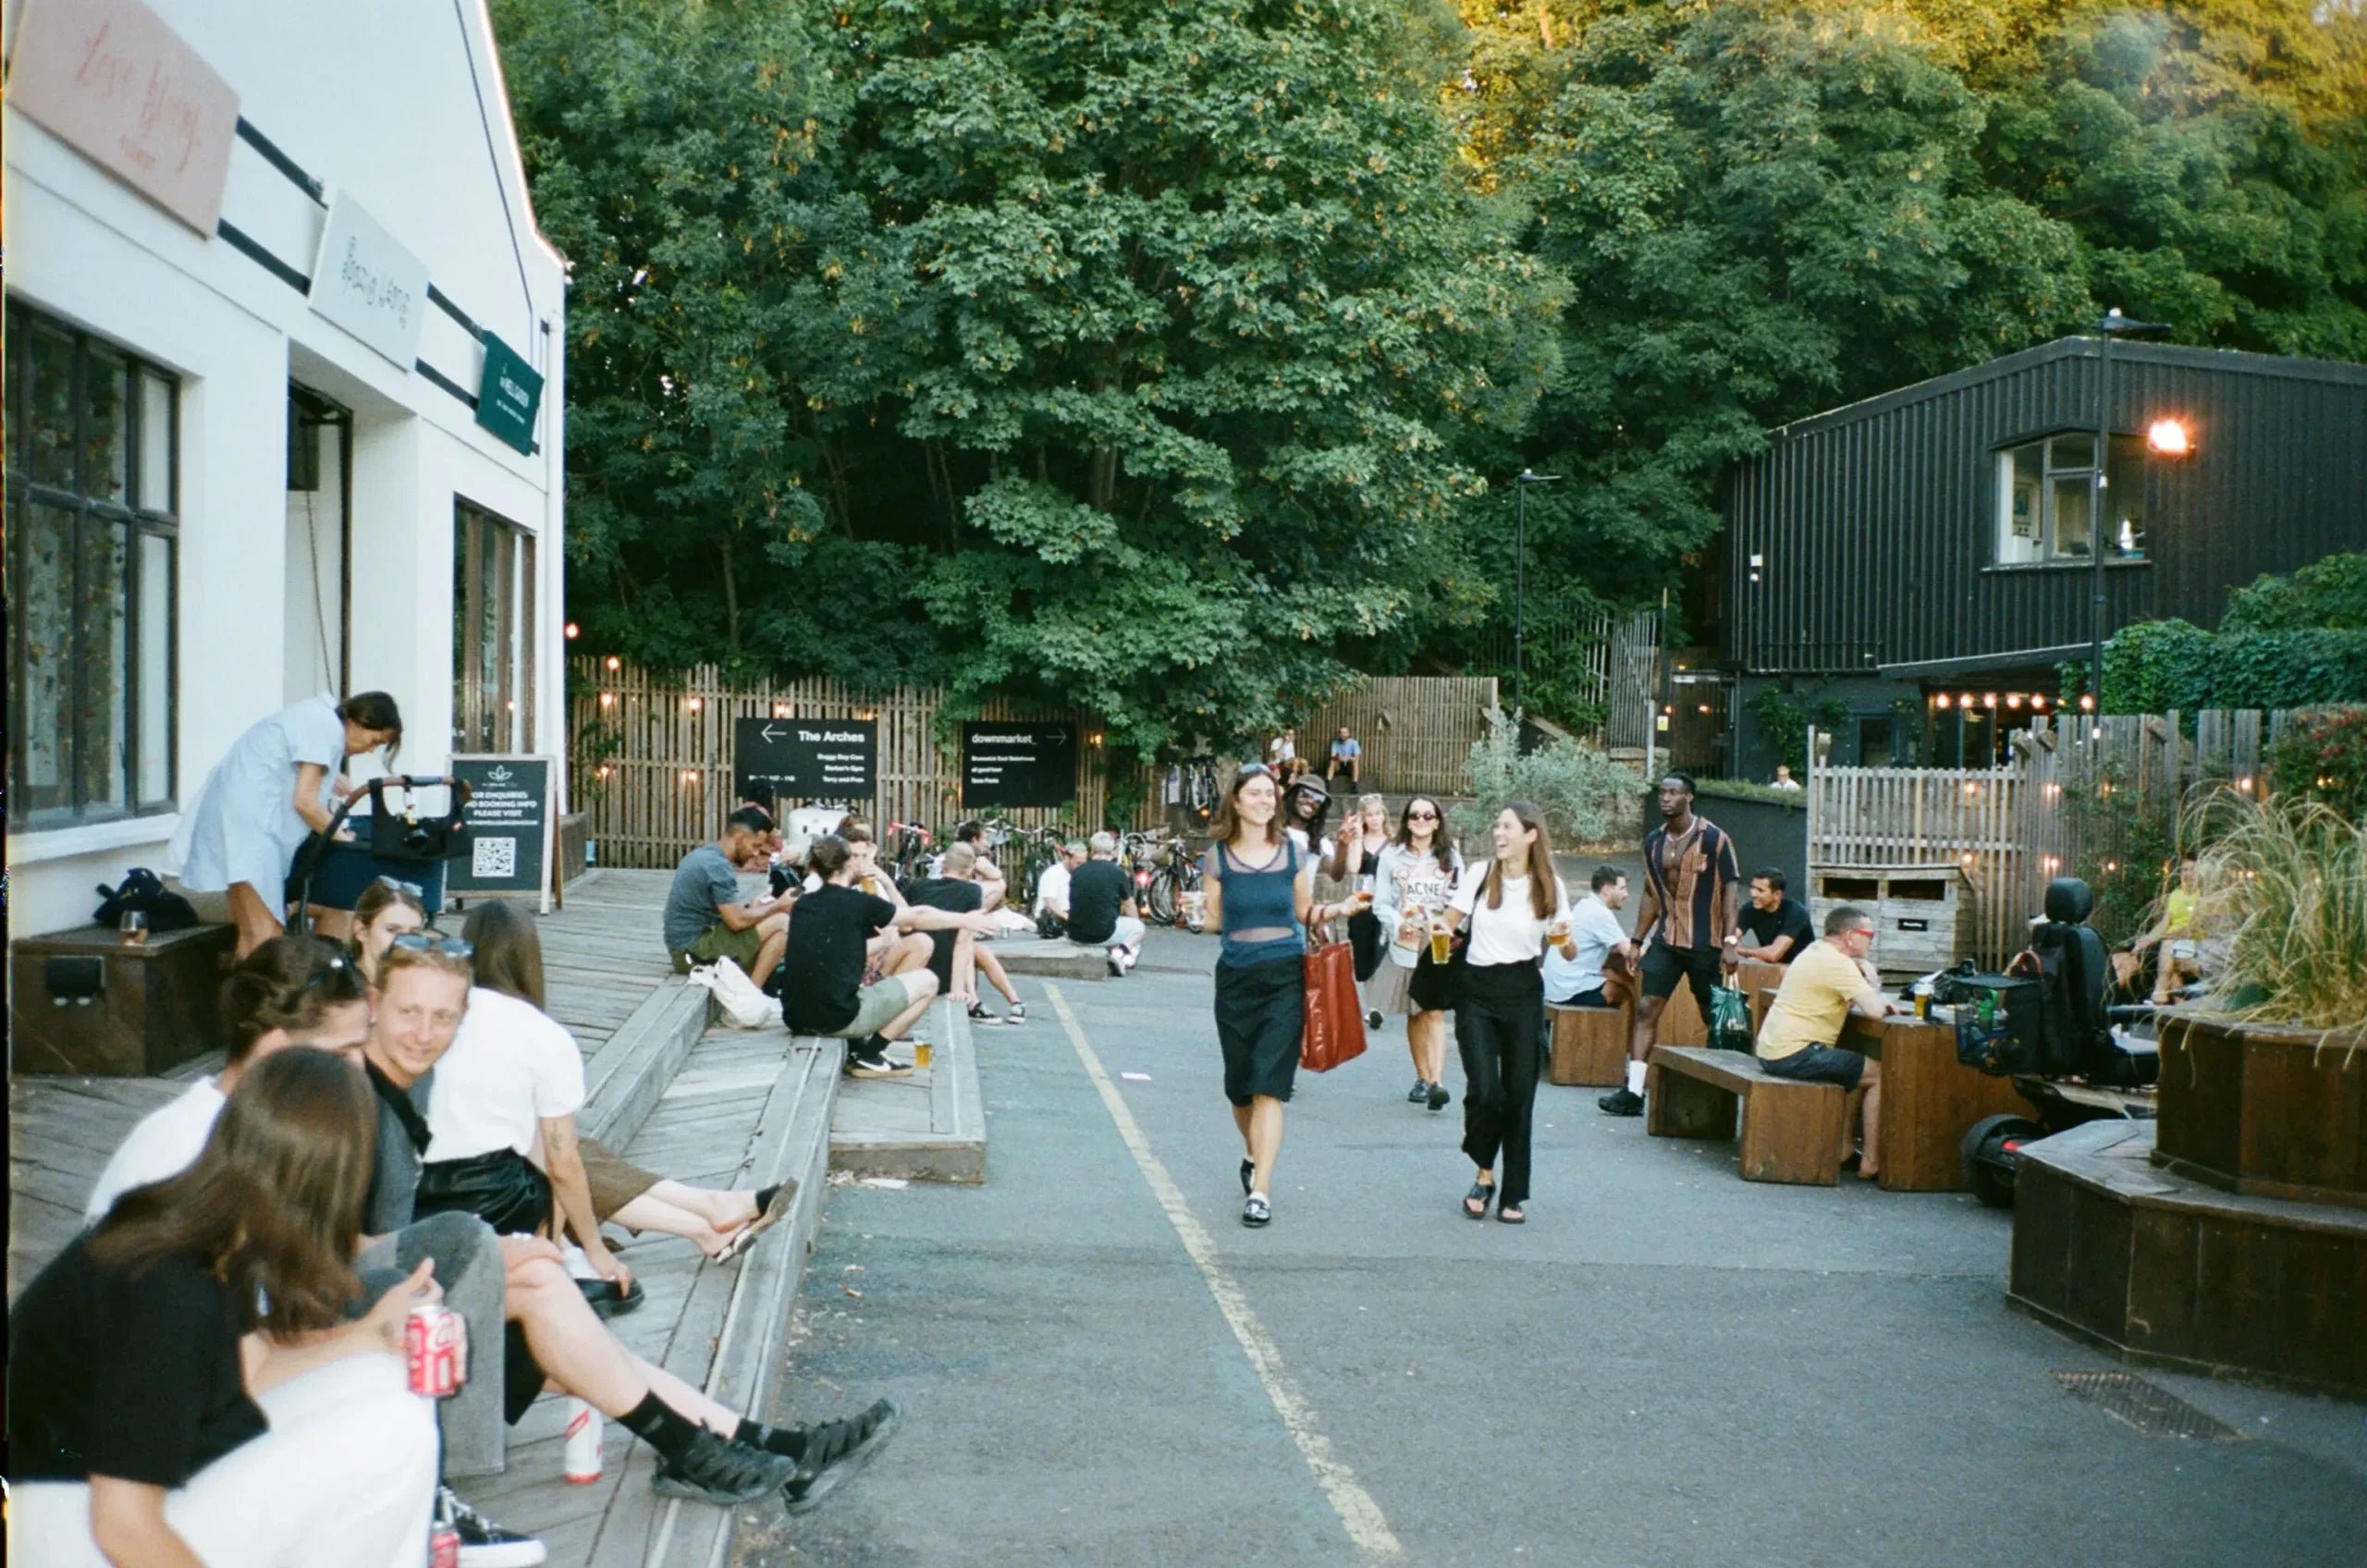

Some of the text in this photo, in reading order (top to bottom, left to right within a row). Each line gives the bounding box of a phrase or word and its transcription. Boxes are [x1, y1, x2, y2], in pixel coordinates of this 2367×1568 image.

[798, 730, 865, 742] The Arches
[485, 791, 528, 800] ENQUIRIES
[479, 800, 515, 808] BOOKING
[516, 800, 537, 808] INFO
[473, 809, 501, 817] PLEASE
[1406, 882, 1441, 896] ACNE
